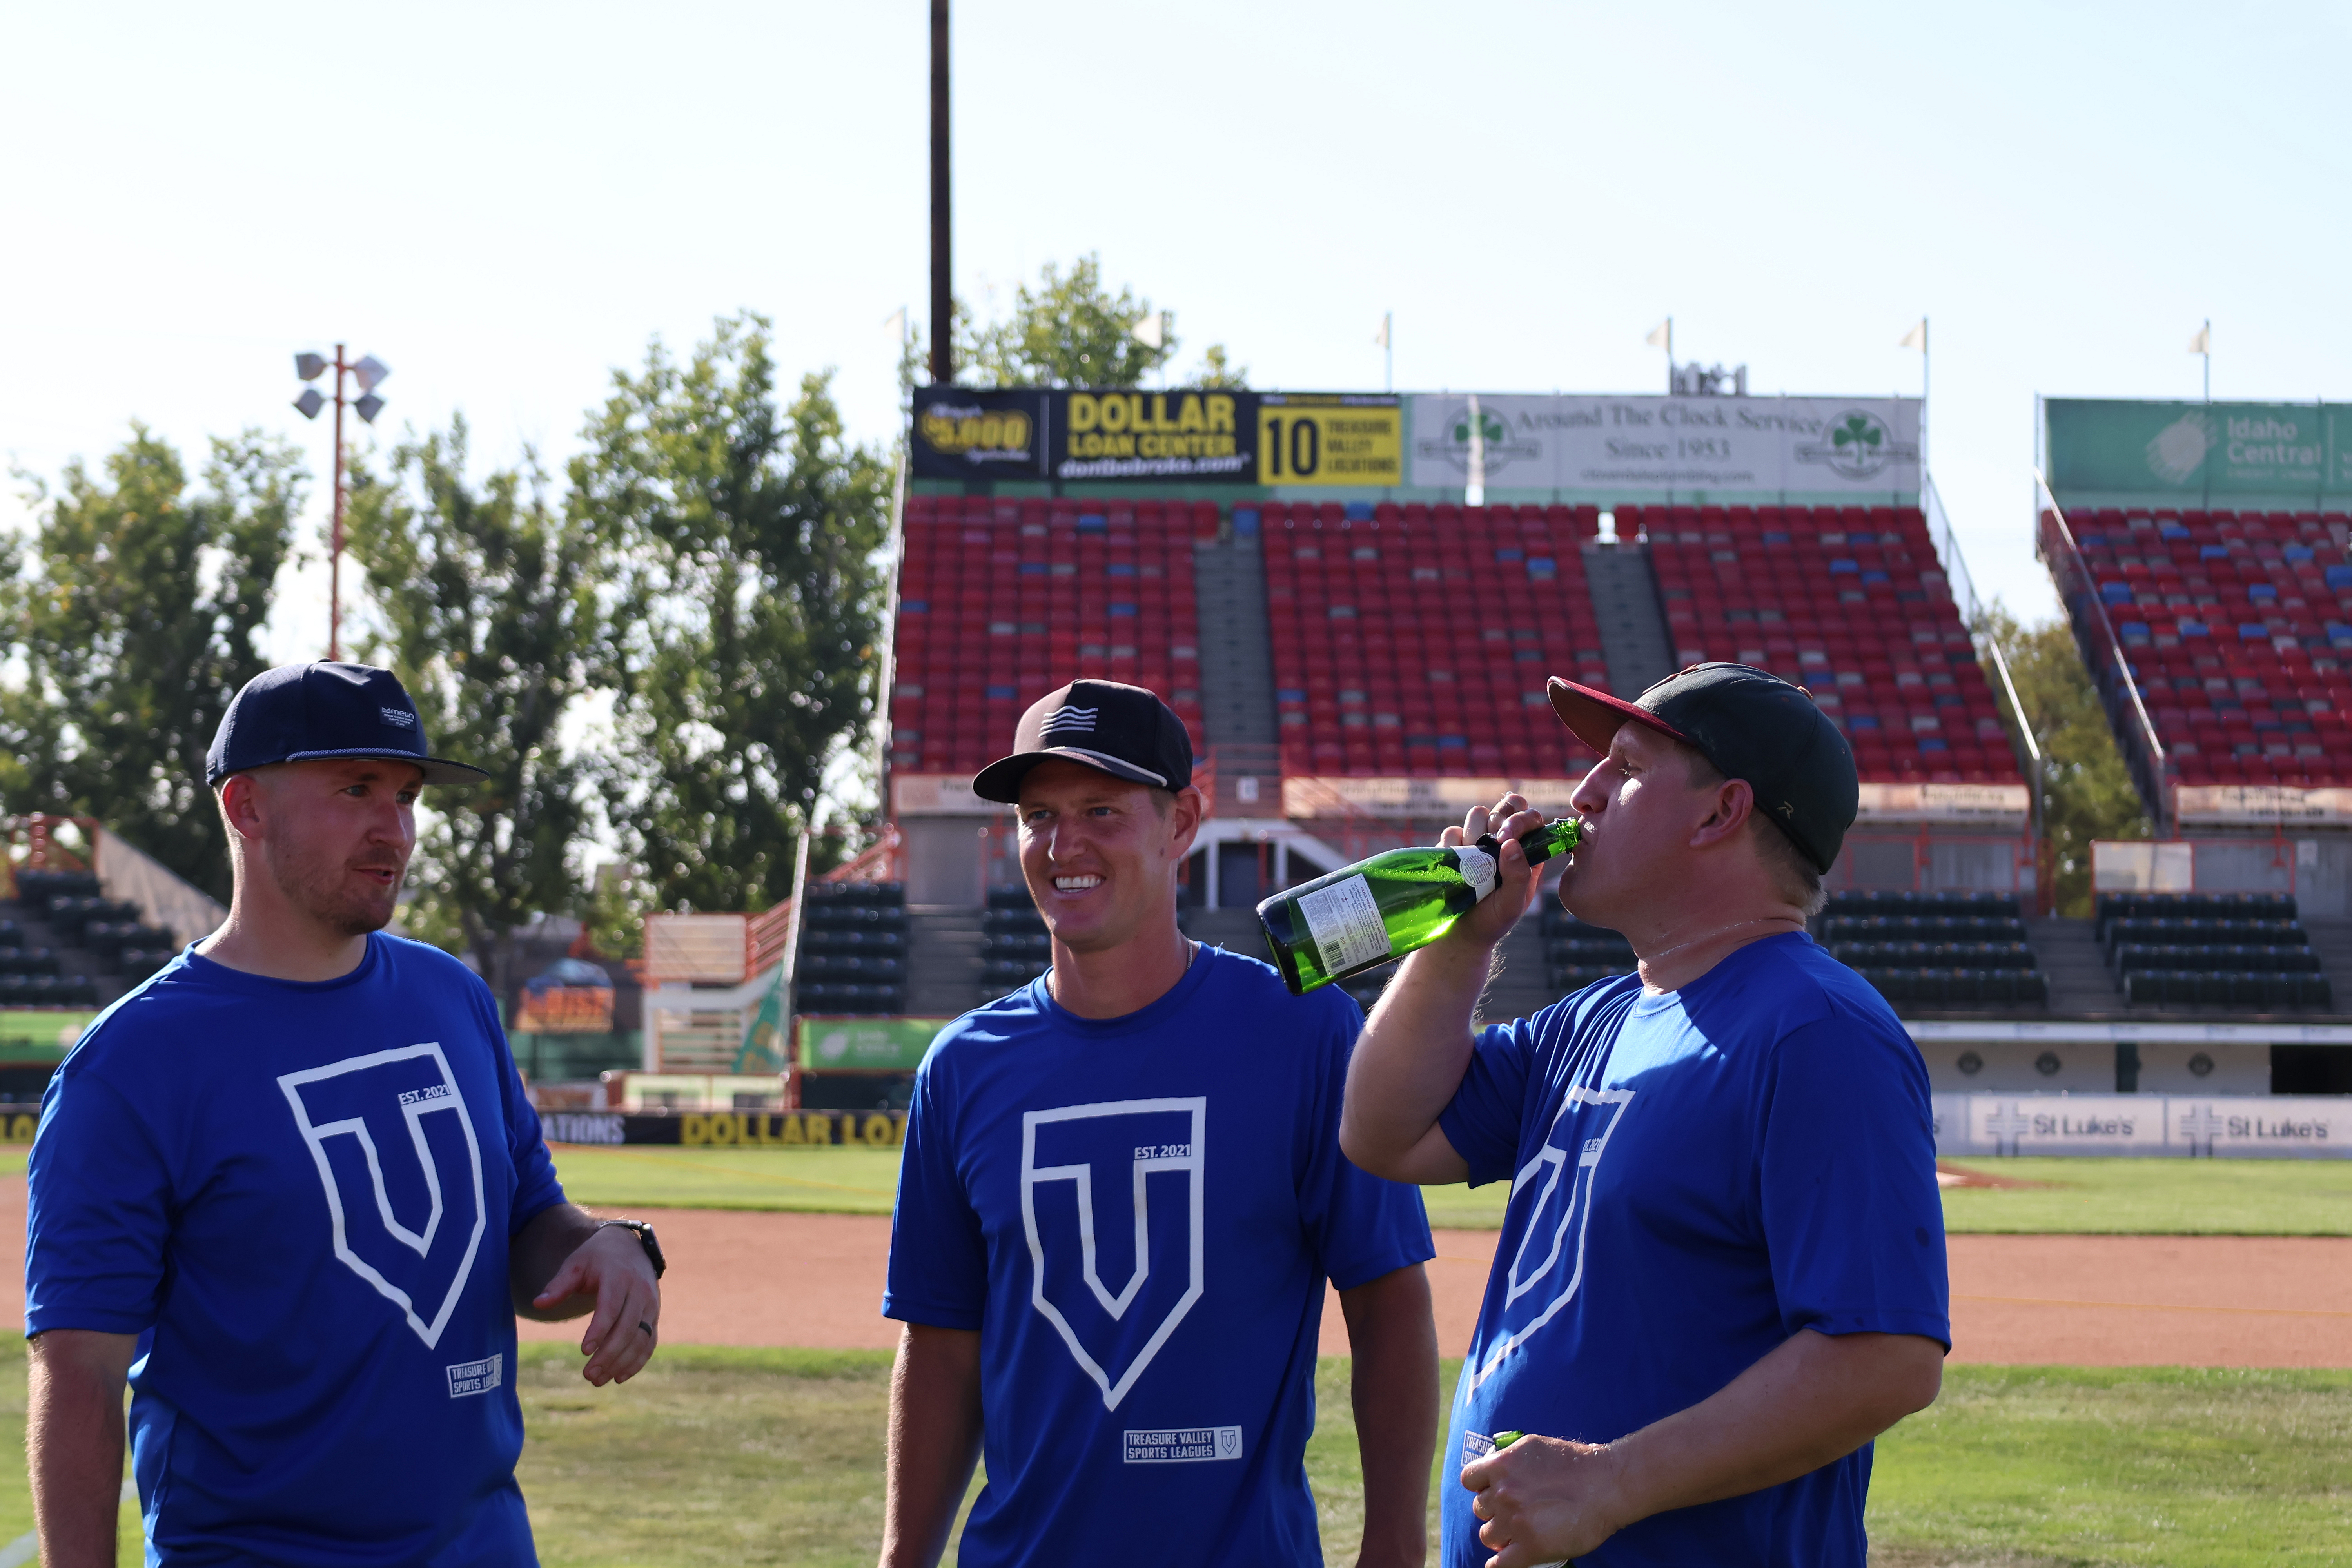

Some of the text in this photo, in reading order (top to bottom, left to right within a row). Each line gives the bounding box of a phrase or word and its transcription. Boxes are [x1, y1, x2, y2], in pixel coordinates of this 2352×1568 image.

[1067, 394, 1236, 432] DOLLAR
[1516, 403, 1823, 434] Around The Clock Service
[2227, 416, 2298, 441] Idaho
[1066, 434, 1236, 457] LOAN CENTER
[1267, 417, 1319, 476] 10
[1605, 437, 1731, 461] Since 1953
[2227, 440, 2323, 465] Central
[391, 709, 414, 719] melin
[398, 1084, 451, 1105] EST. 2021
[542, 1112, 909, 1145] ATIONS DOLLAR LO
[2033, 1113, 2135, 1135] St Luke's
[2228, 1115, 2328, 1138] St Luke's
[1134, 1144, 1191, 1160] EST. 2021
[452, 1363, 486, 1379] TREASURE
[454, 1378, 481, 1393] SPORTS
[1129, 1431, 1212, 1445] TREASURE VALLEY
[1466, 1435, 1492, 1454] TREASUR
[1128, 1445, 1213, 1459] SPORTS LEAGUES
[1464, 1450, 1483, 1463] SPOR
